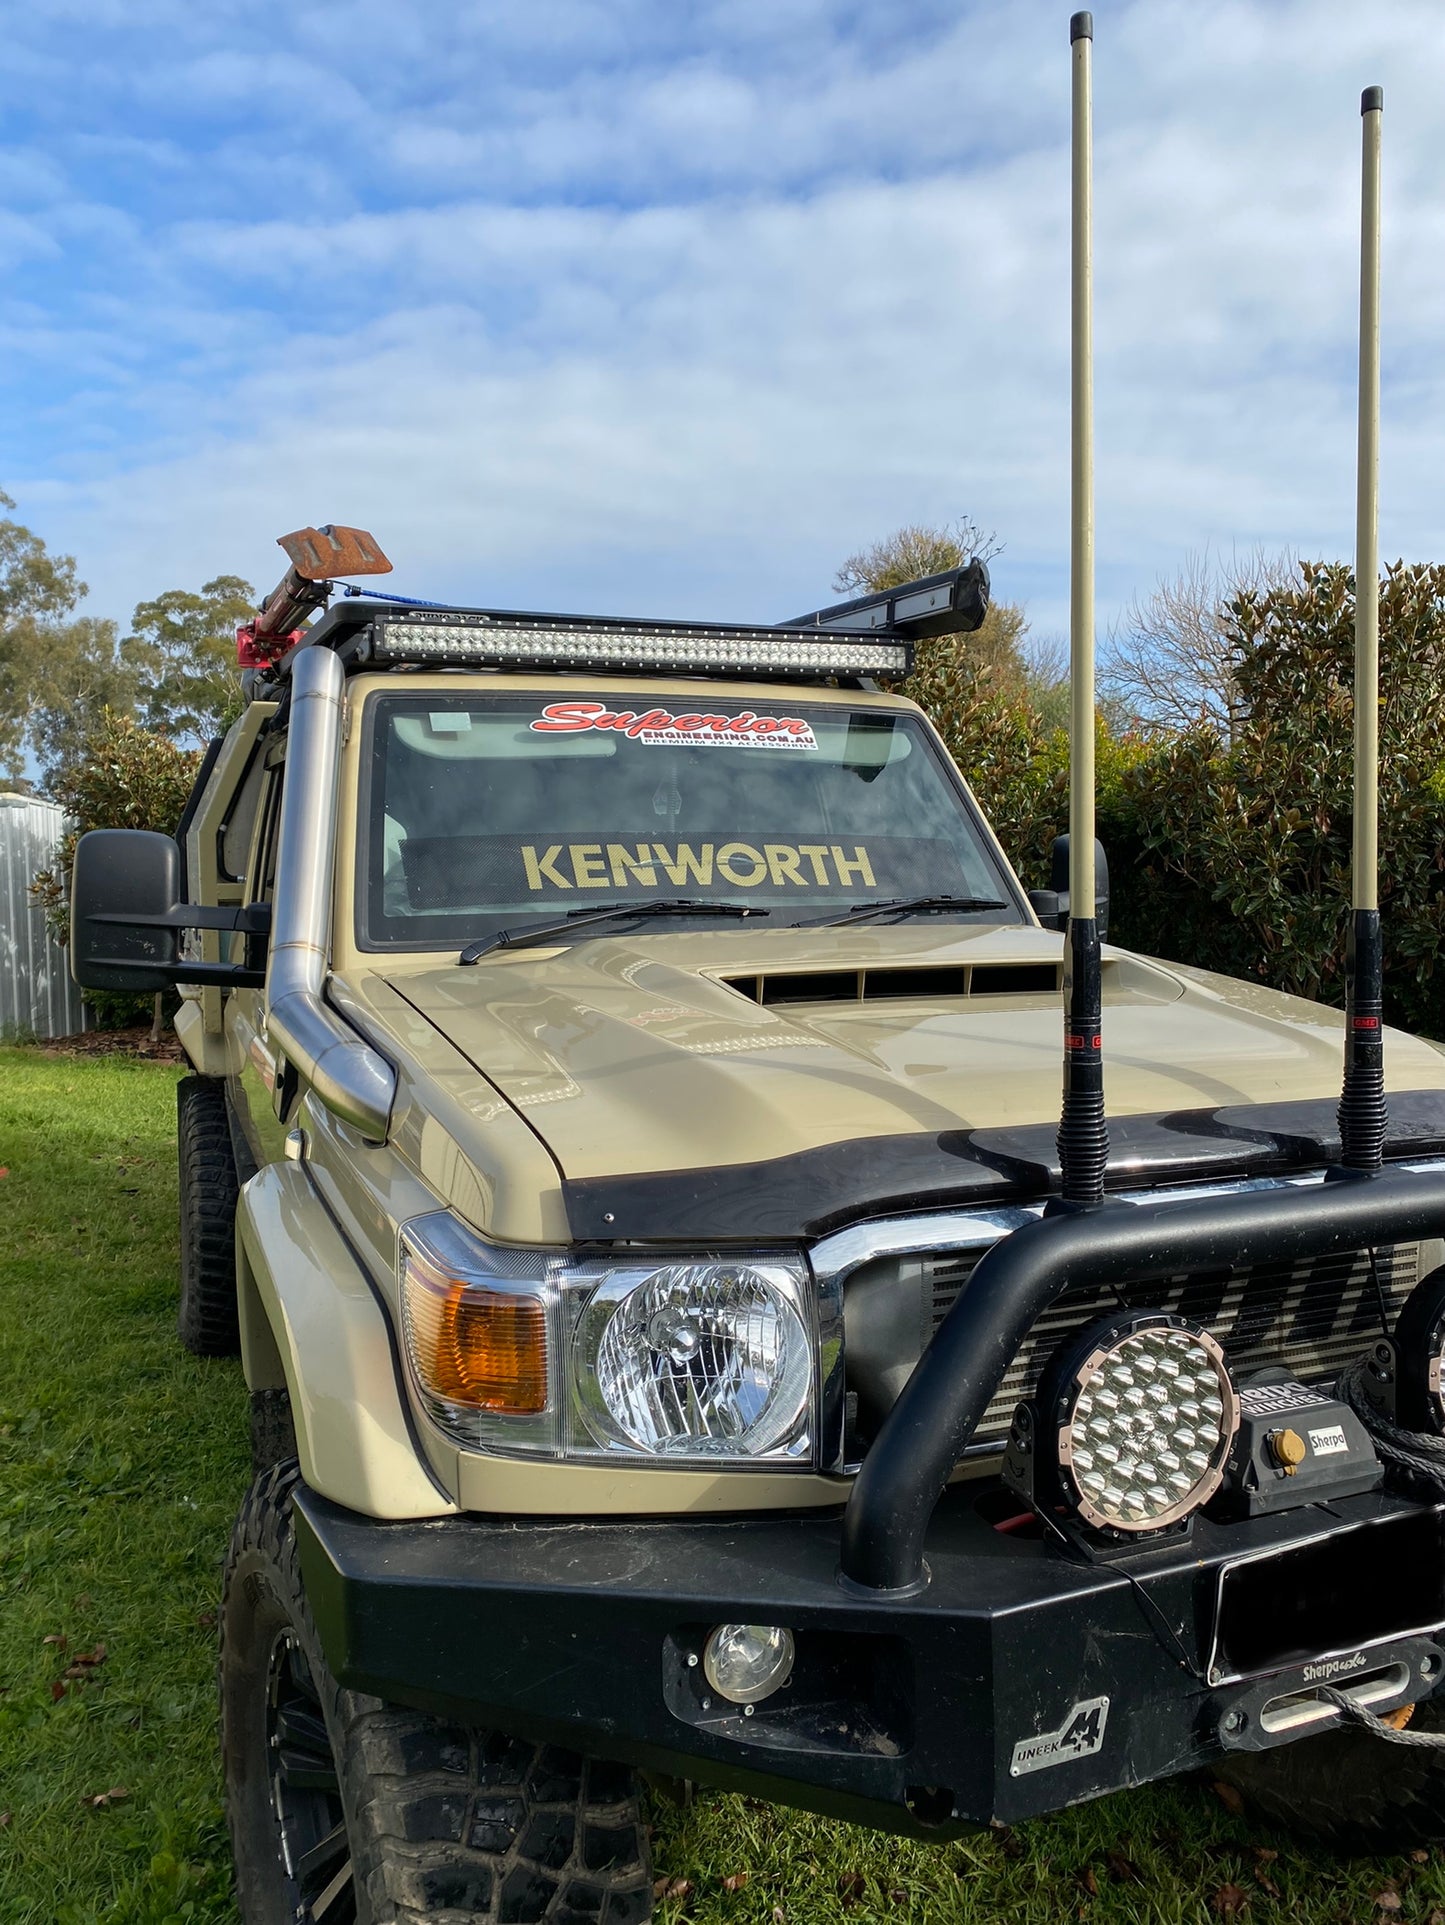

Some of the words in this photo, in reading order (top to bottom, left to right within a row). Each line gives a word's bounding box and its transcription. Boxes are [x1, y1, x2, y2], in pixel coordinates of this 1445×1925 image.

[531, 703, 810, 737] Superior
[643, 731, 814, 743] ENGINEERING.COM.AU
[738, 741, 817, 749] ACCESSORIES
[521, 843, 877, 890] KENWORTH
[1241, 1392, 1325, 1414] WINCHES
[1310, 1432, 1345, 1450] Sherpa
[1017, 1740, 1060, 1761] UNEEK
